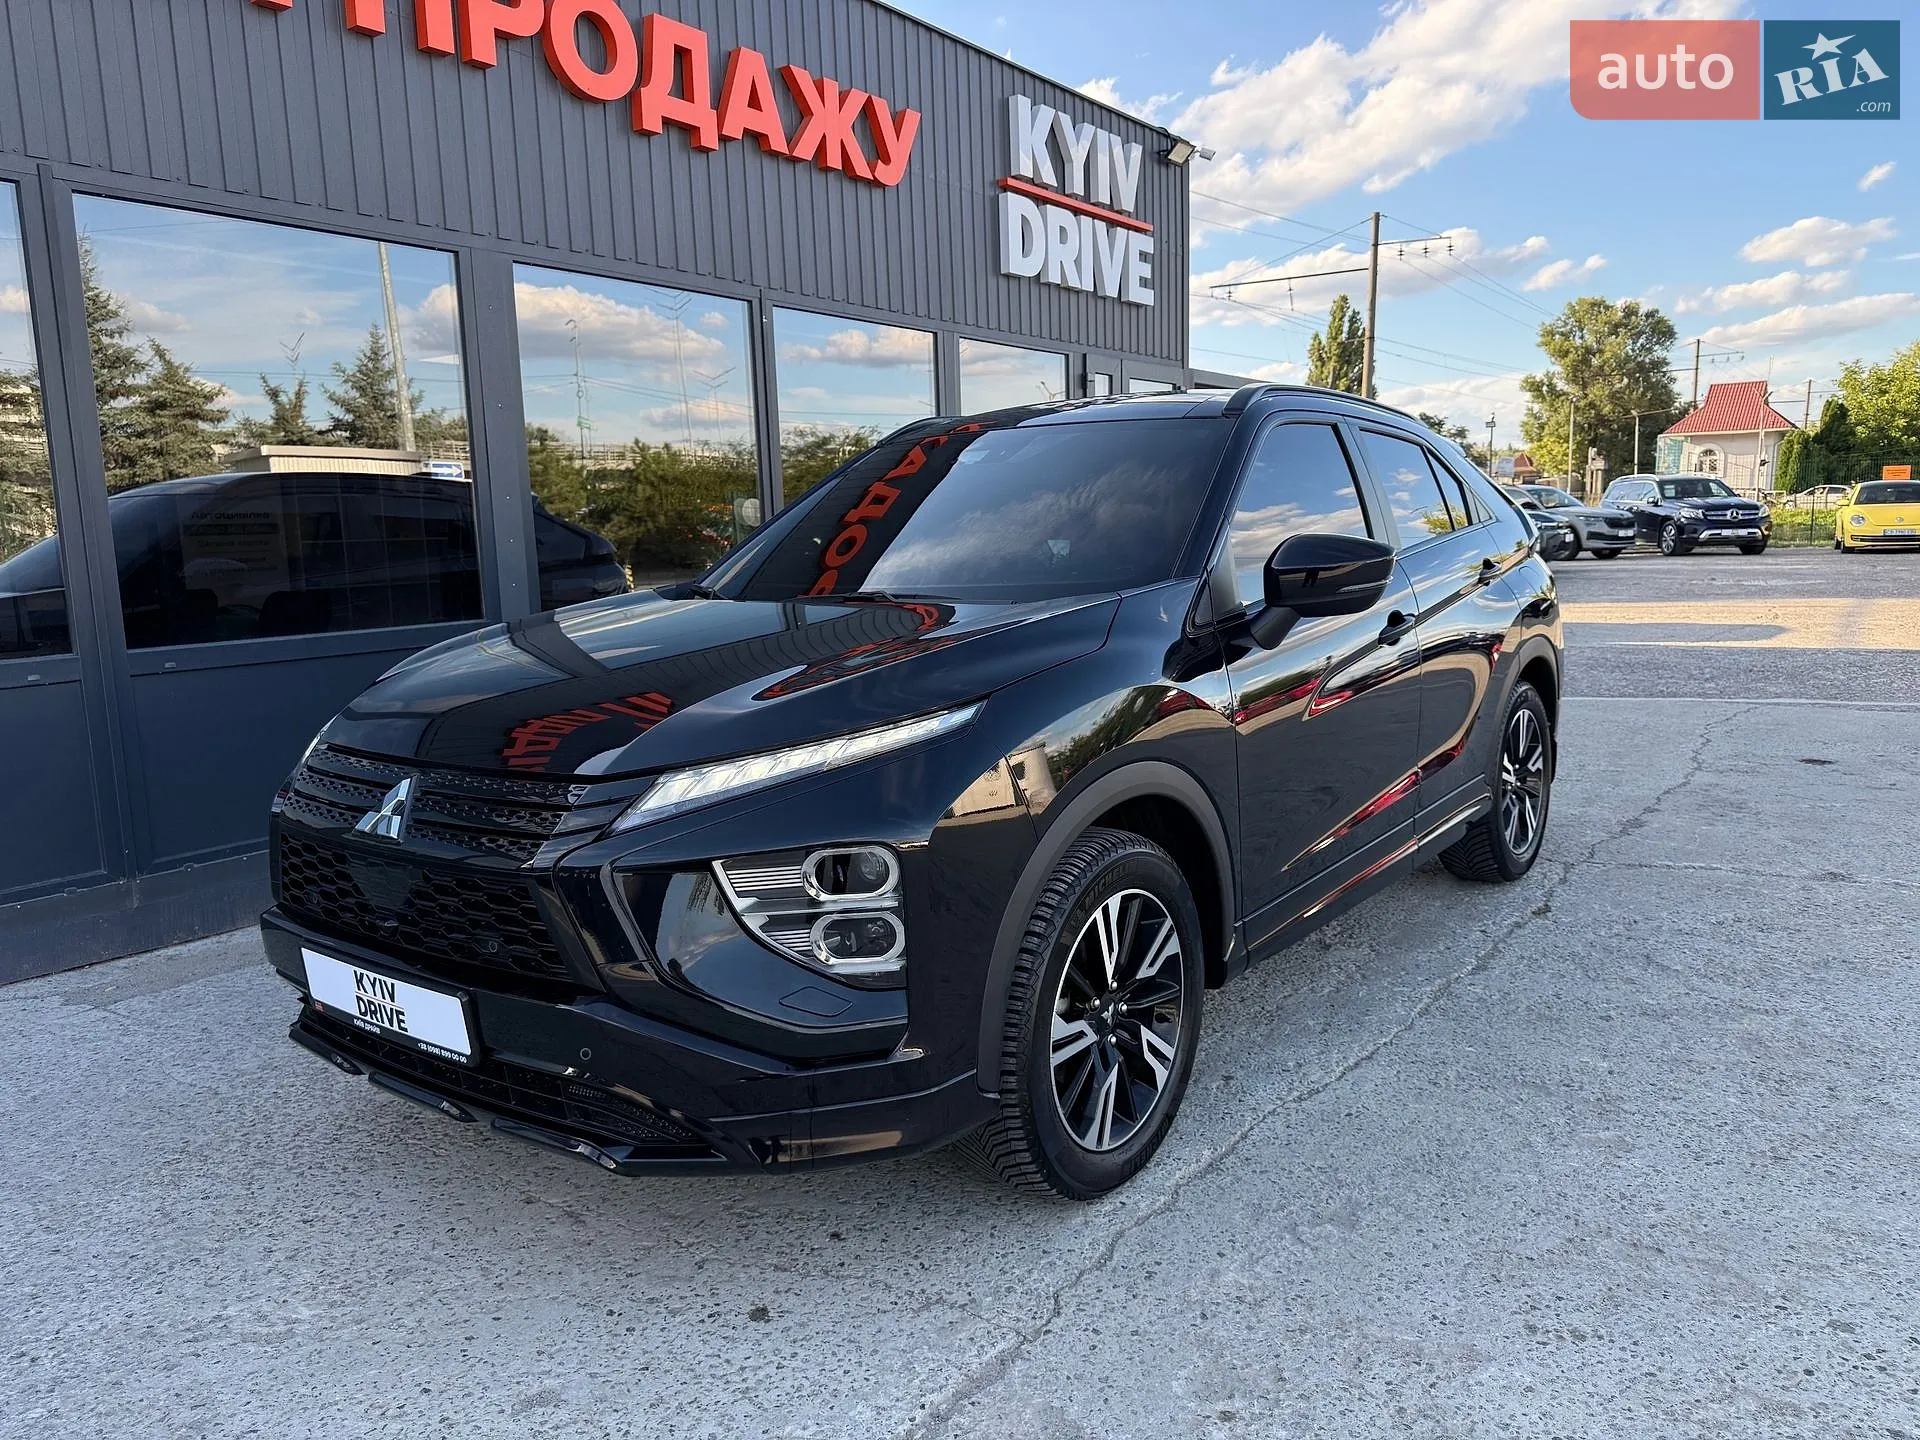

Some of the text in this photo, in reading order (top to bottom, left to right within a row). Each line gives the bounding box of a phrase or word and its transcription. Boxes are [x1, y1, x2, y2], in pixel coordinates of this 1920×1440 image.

[1008, 94, 1143, 213] KYIV
[999, 191, 1155, 306] DRIVE
[353, 969, 396, 1003] KYIV
[355, 995, 408, 1033] DRIVE
